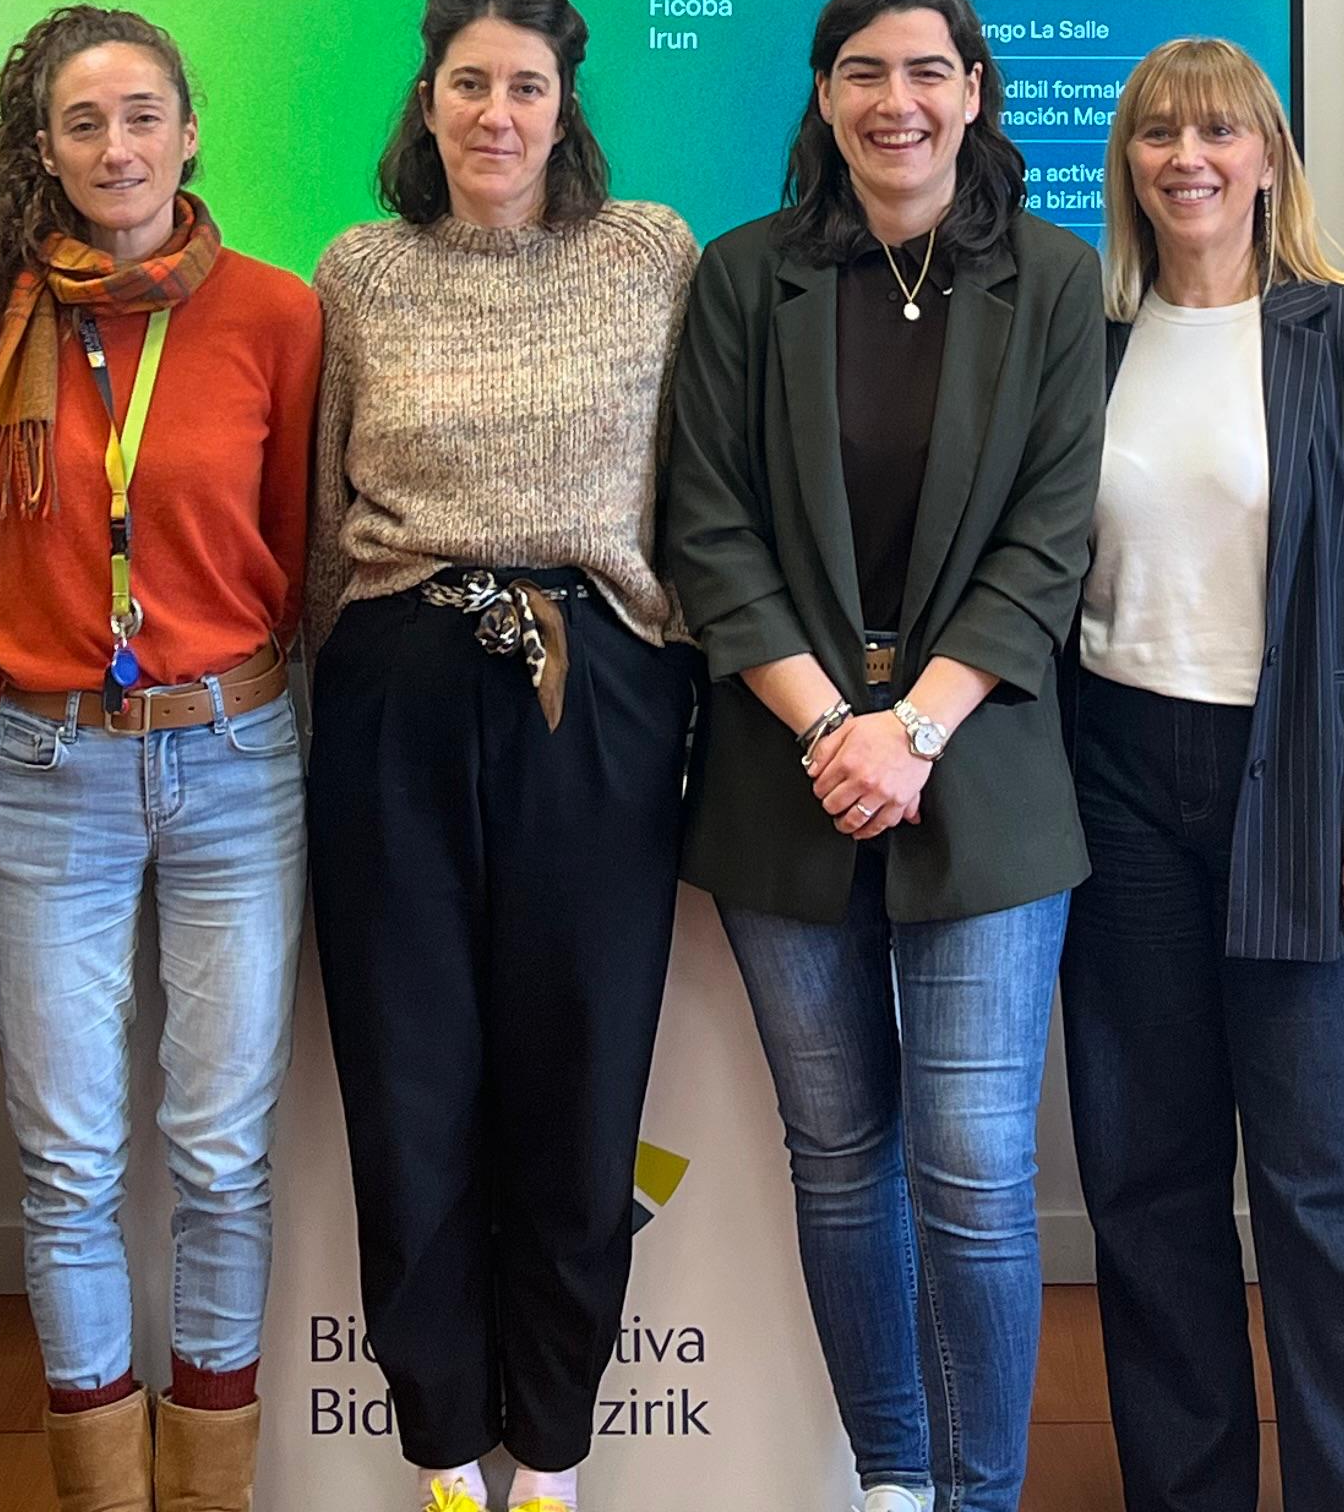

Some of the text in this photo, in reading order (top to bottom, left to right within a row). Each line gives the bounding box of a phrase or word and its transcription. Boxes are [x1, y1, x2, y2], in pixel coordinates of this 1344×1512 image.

[649, 26, 698, 49] Irun
[981, 20, 1109, 43] ngo La Salle
[1005, 80, 1126, 99] dibil formak
[998, 106, 1069, 126] mación
[615, 1316, 705, 1363] tiva
[597, 1388, 712, 1435] zirik
